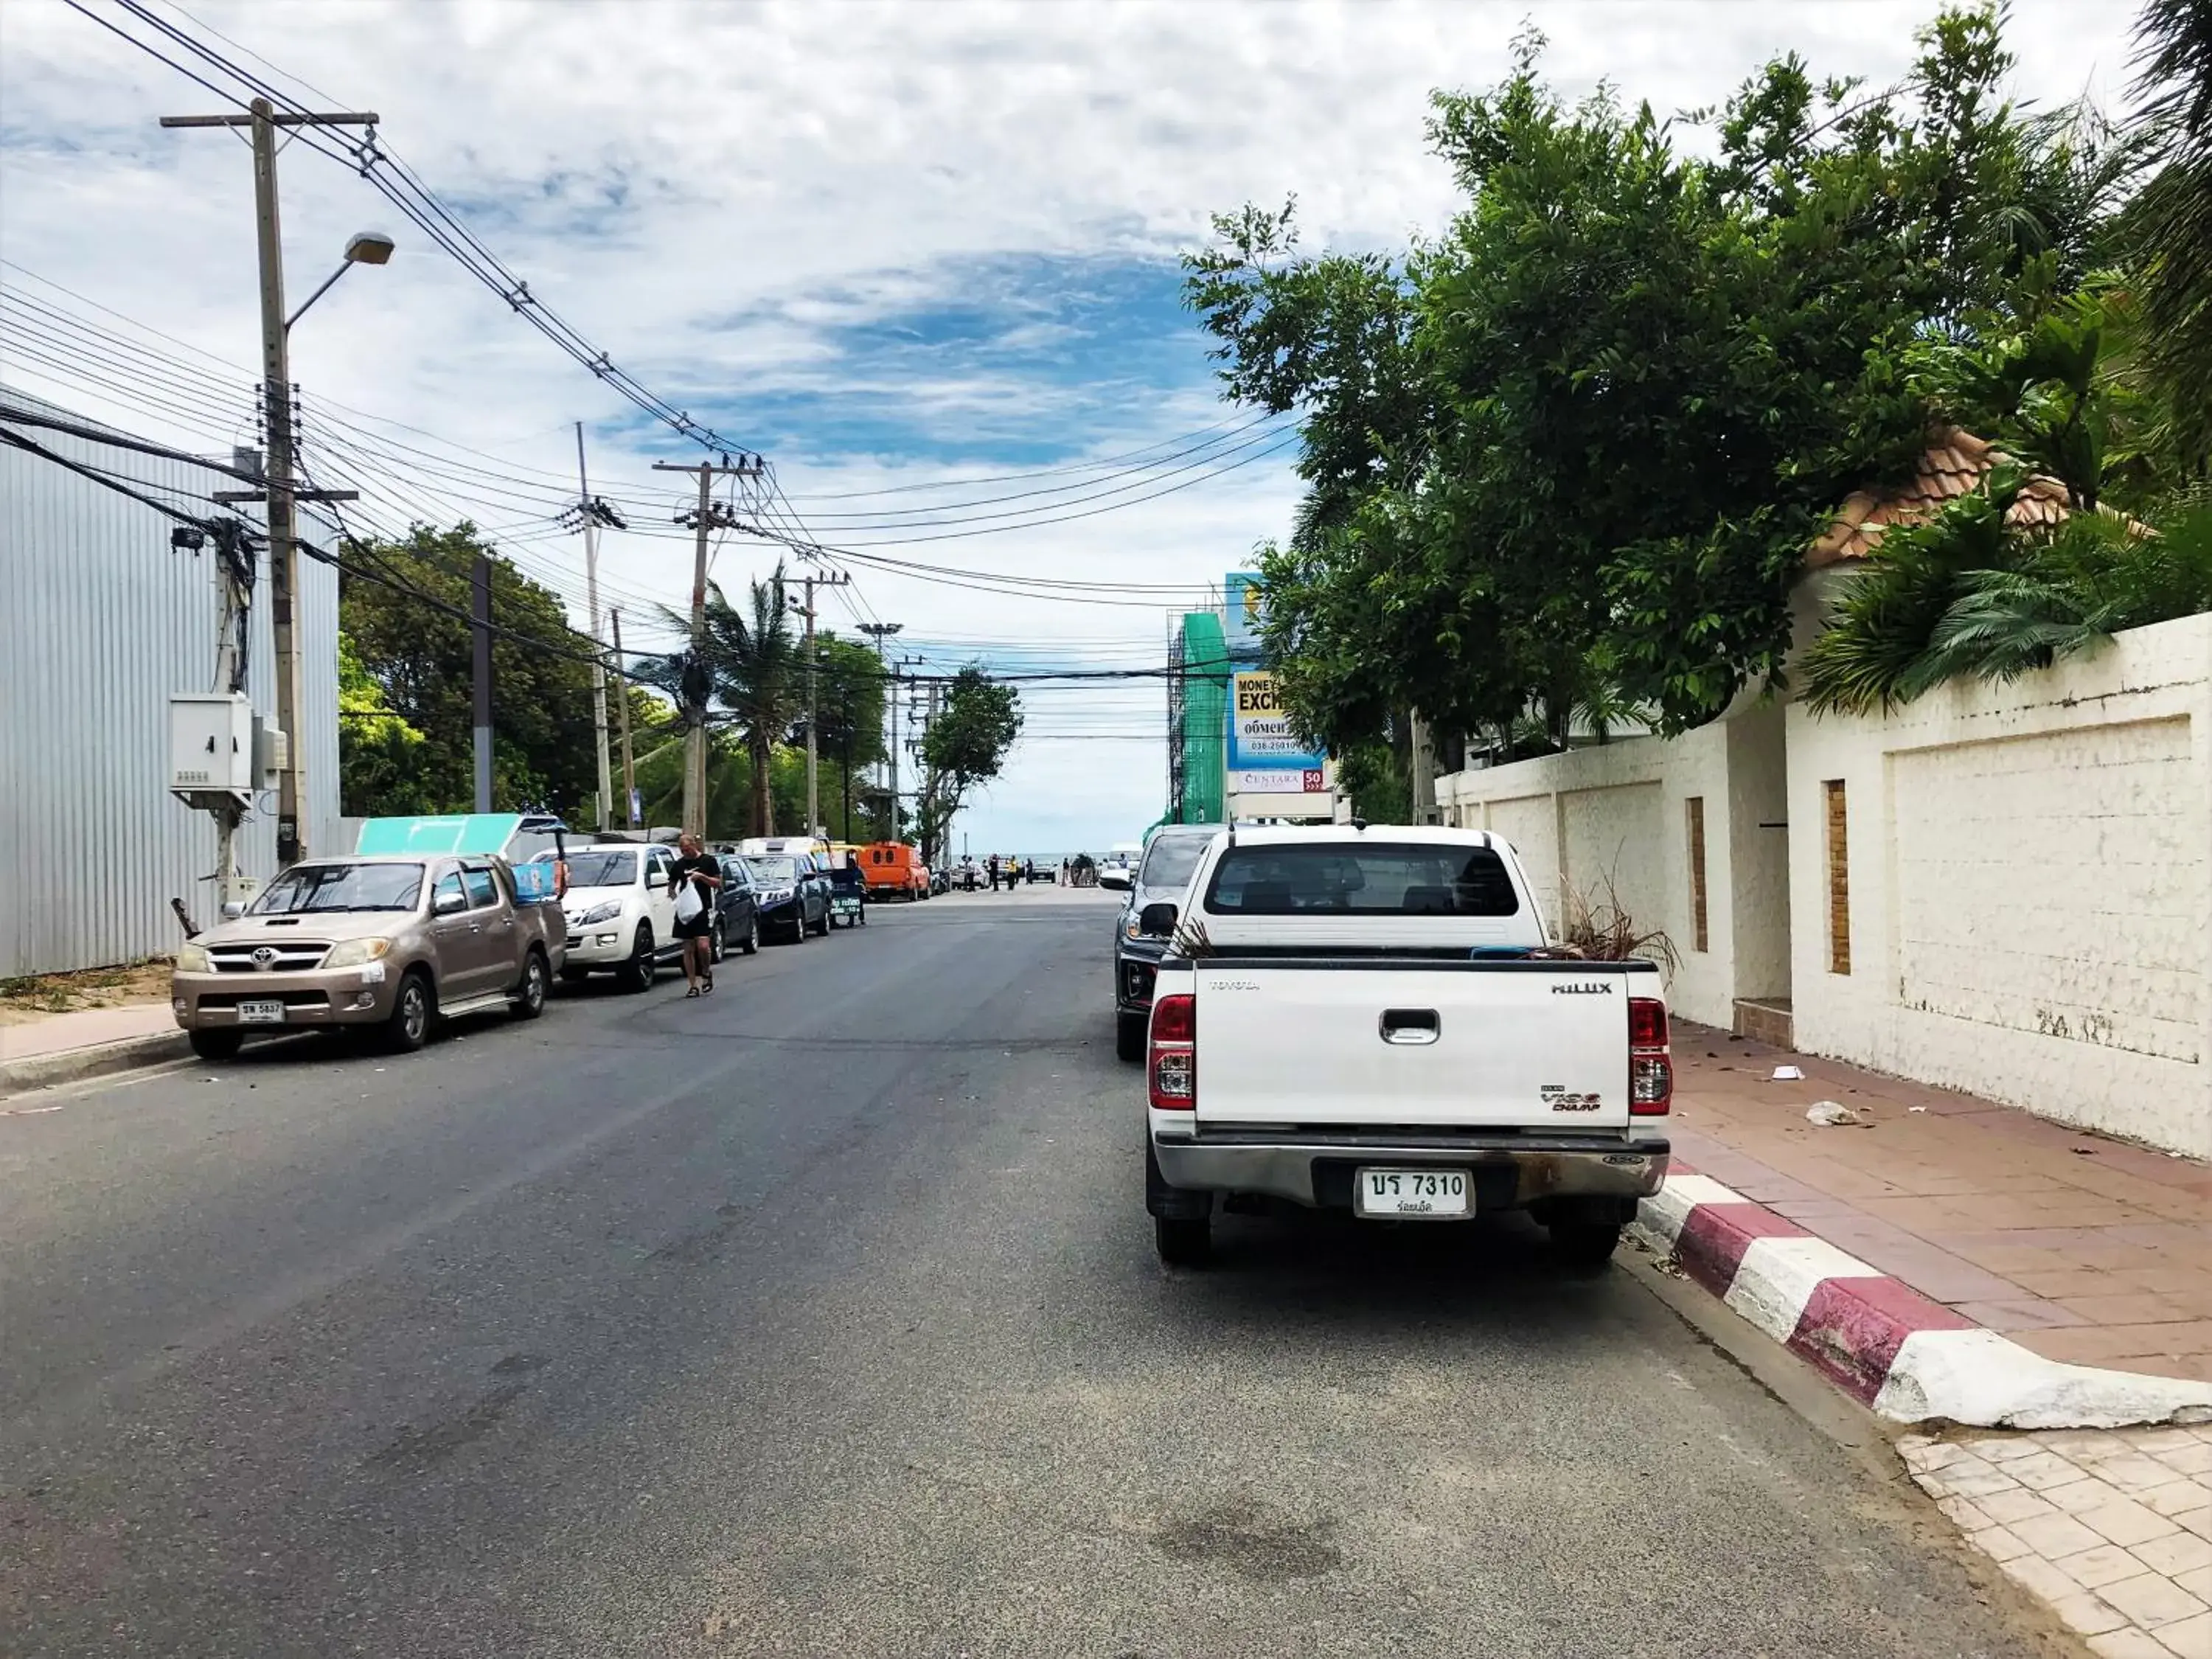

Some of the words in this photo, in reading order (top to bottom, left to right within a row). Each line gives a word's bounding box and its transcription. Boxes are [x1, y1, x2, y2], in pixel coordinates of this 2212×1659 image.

[1239, 680, 1278, 692] MONEY
[1240, 693, 1284, 710] EXCH
[1305, 772, 1321, 783] 50
[1209, 980, 1261, 990] TOYOTA
[1552, 982, 1613, 995] HILUX
[1552, 1104, 1601, 1112] CHAMP
[1371, 1175, 1401, 1195] บร
[1412, 1175, 1463, 1195] 7310
